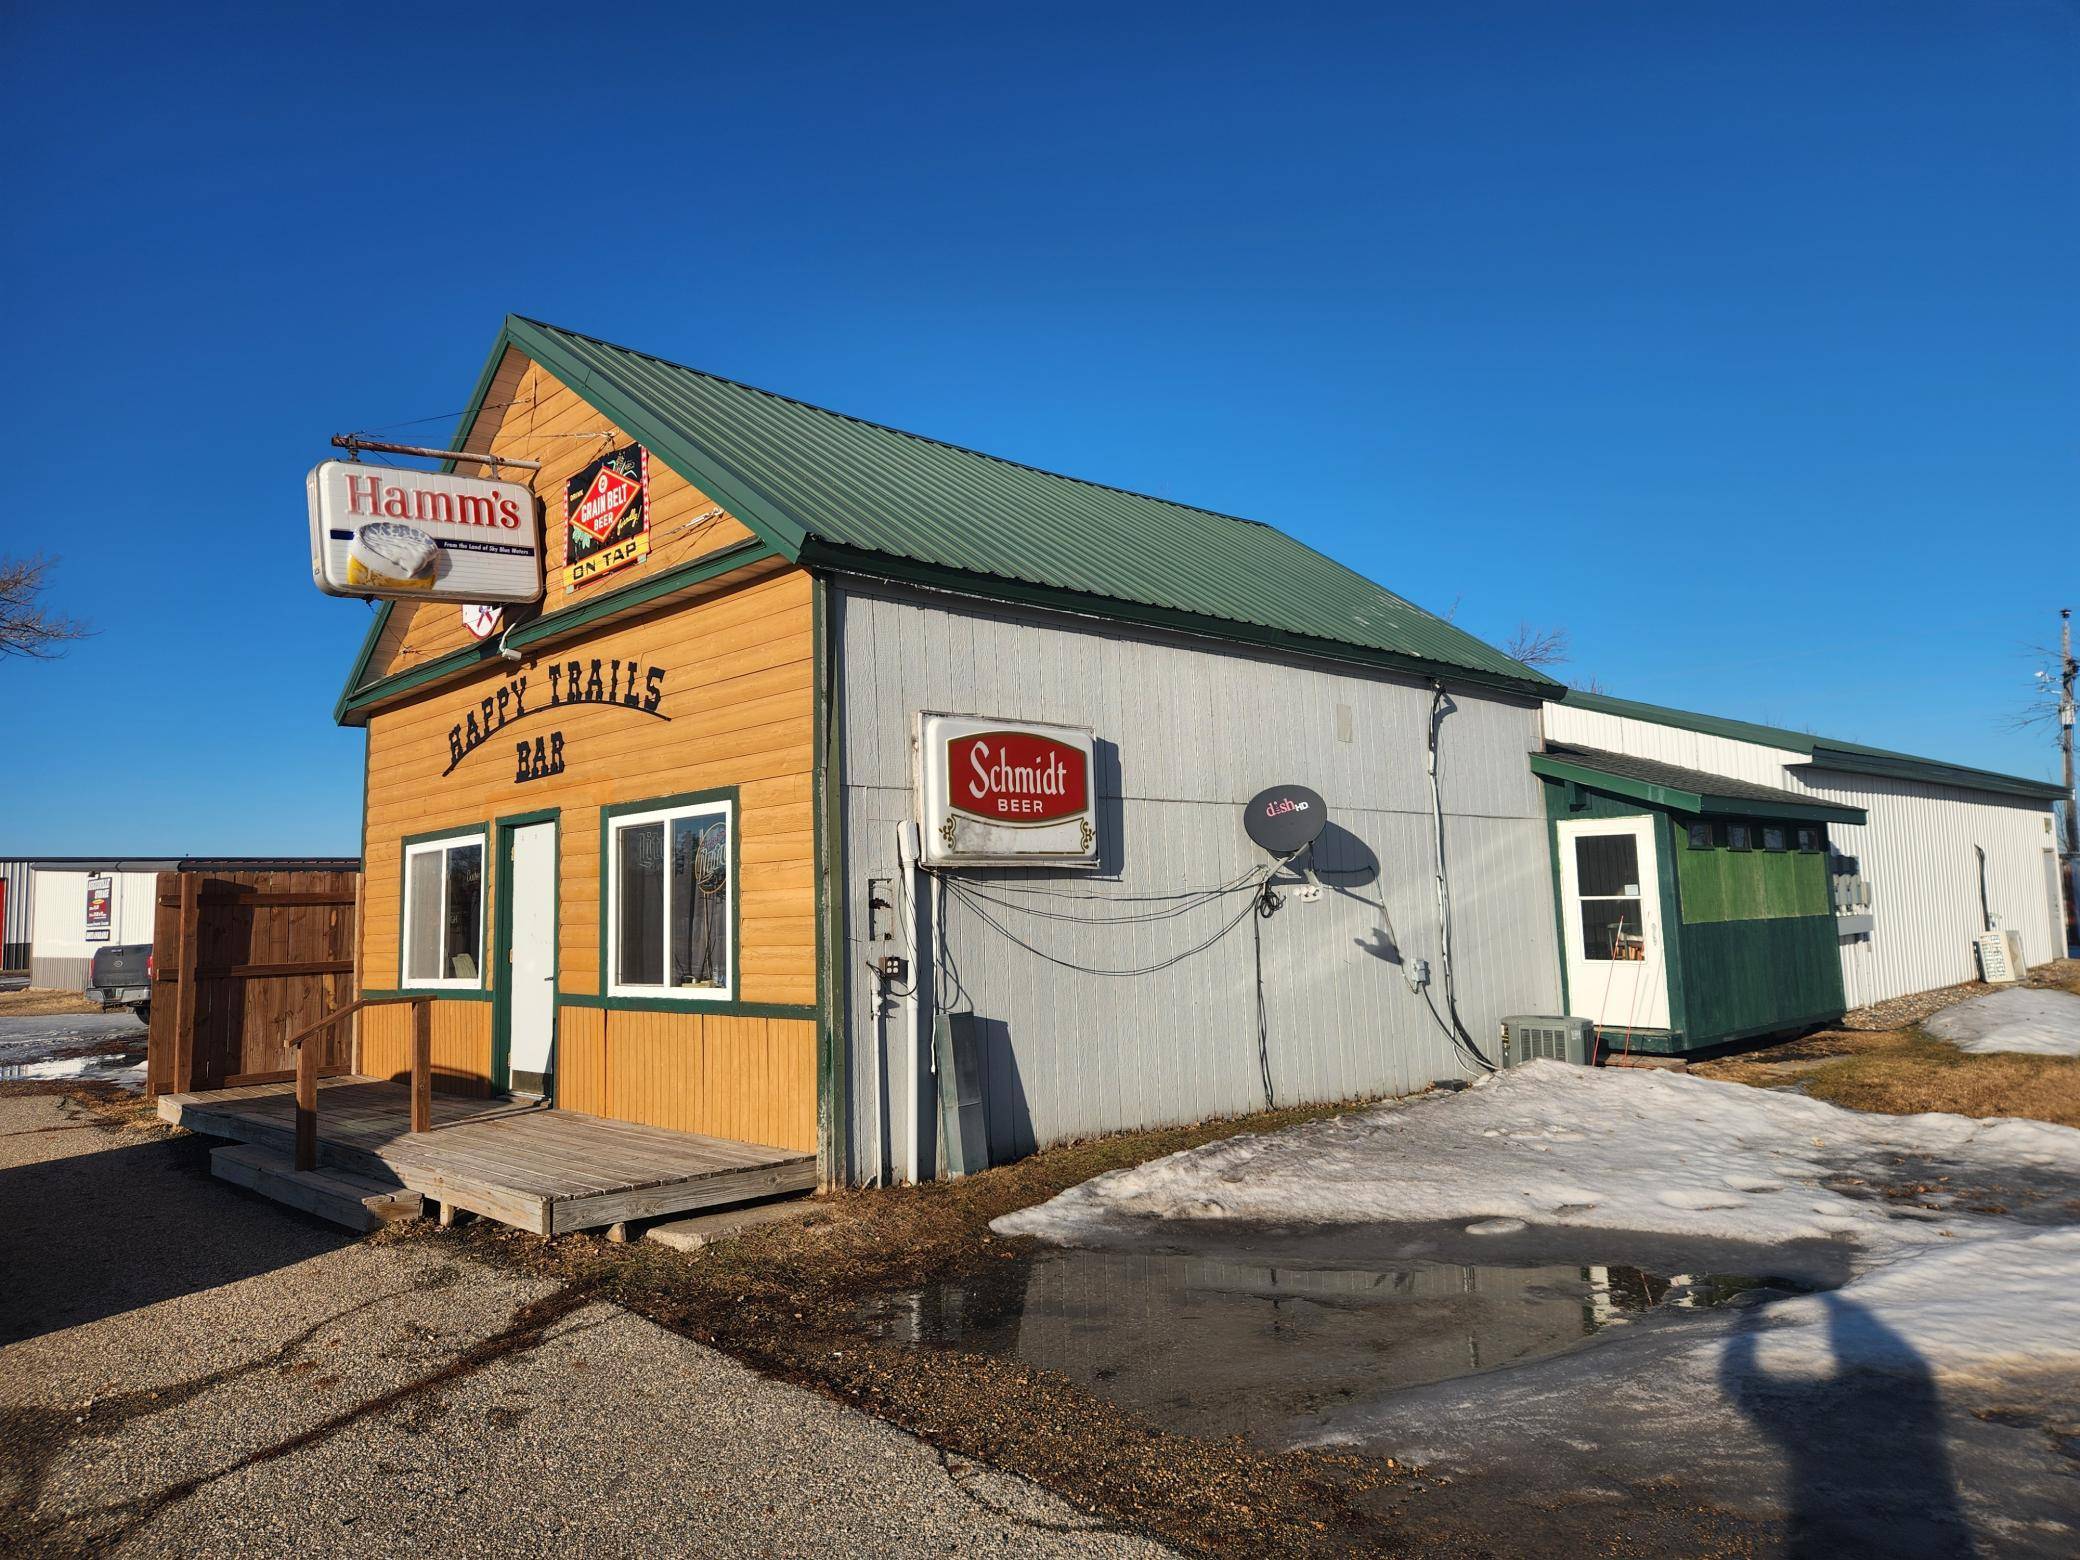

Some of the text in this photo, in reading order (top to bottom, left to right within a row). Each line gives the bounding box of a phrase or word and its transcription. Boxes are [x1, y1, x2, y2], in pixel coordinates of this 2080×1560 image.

[344, 473, 521, 530] Hamm's
[581, 483, 628, 523] GRAIN BELT
[593, 511, 615, 532] BEER
[468, 543, 482, 551] Land
[573, 541, 637, 580] ON TAP
[449, 659, 666, 764] HAPPY TRAILS
[515, 730, 566, 783] BAR
[968, 740, 1067, 799] Schmidt
[997, 798, 1043, 813] BEER
